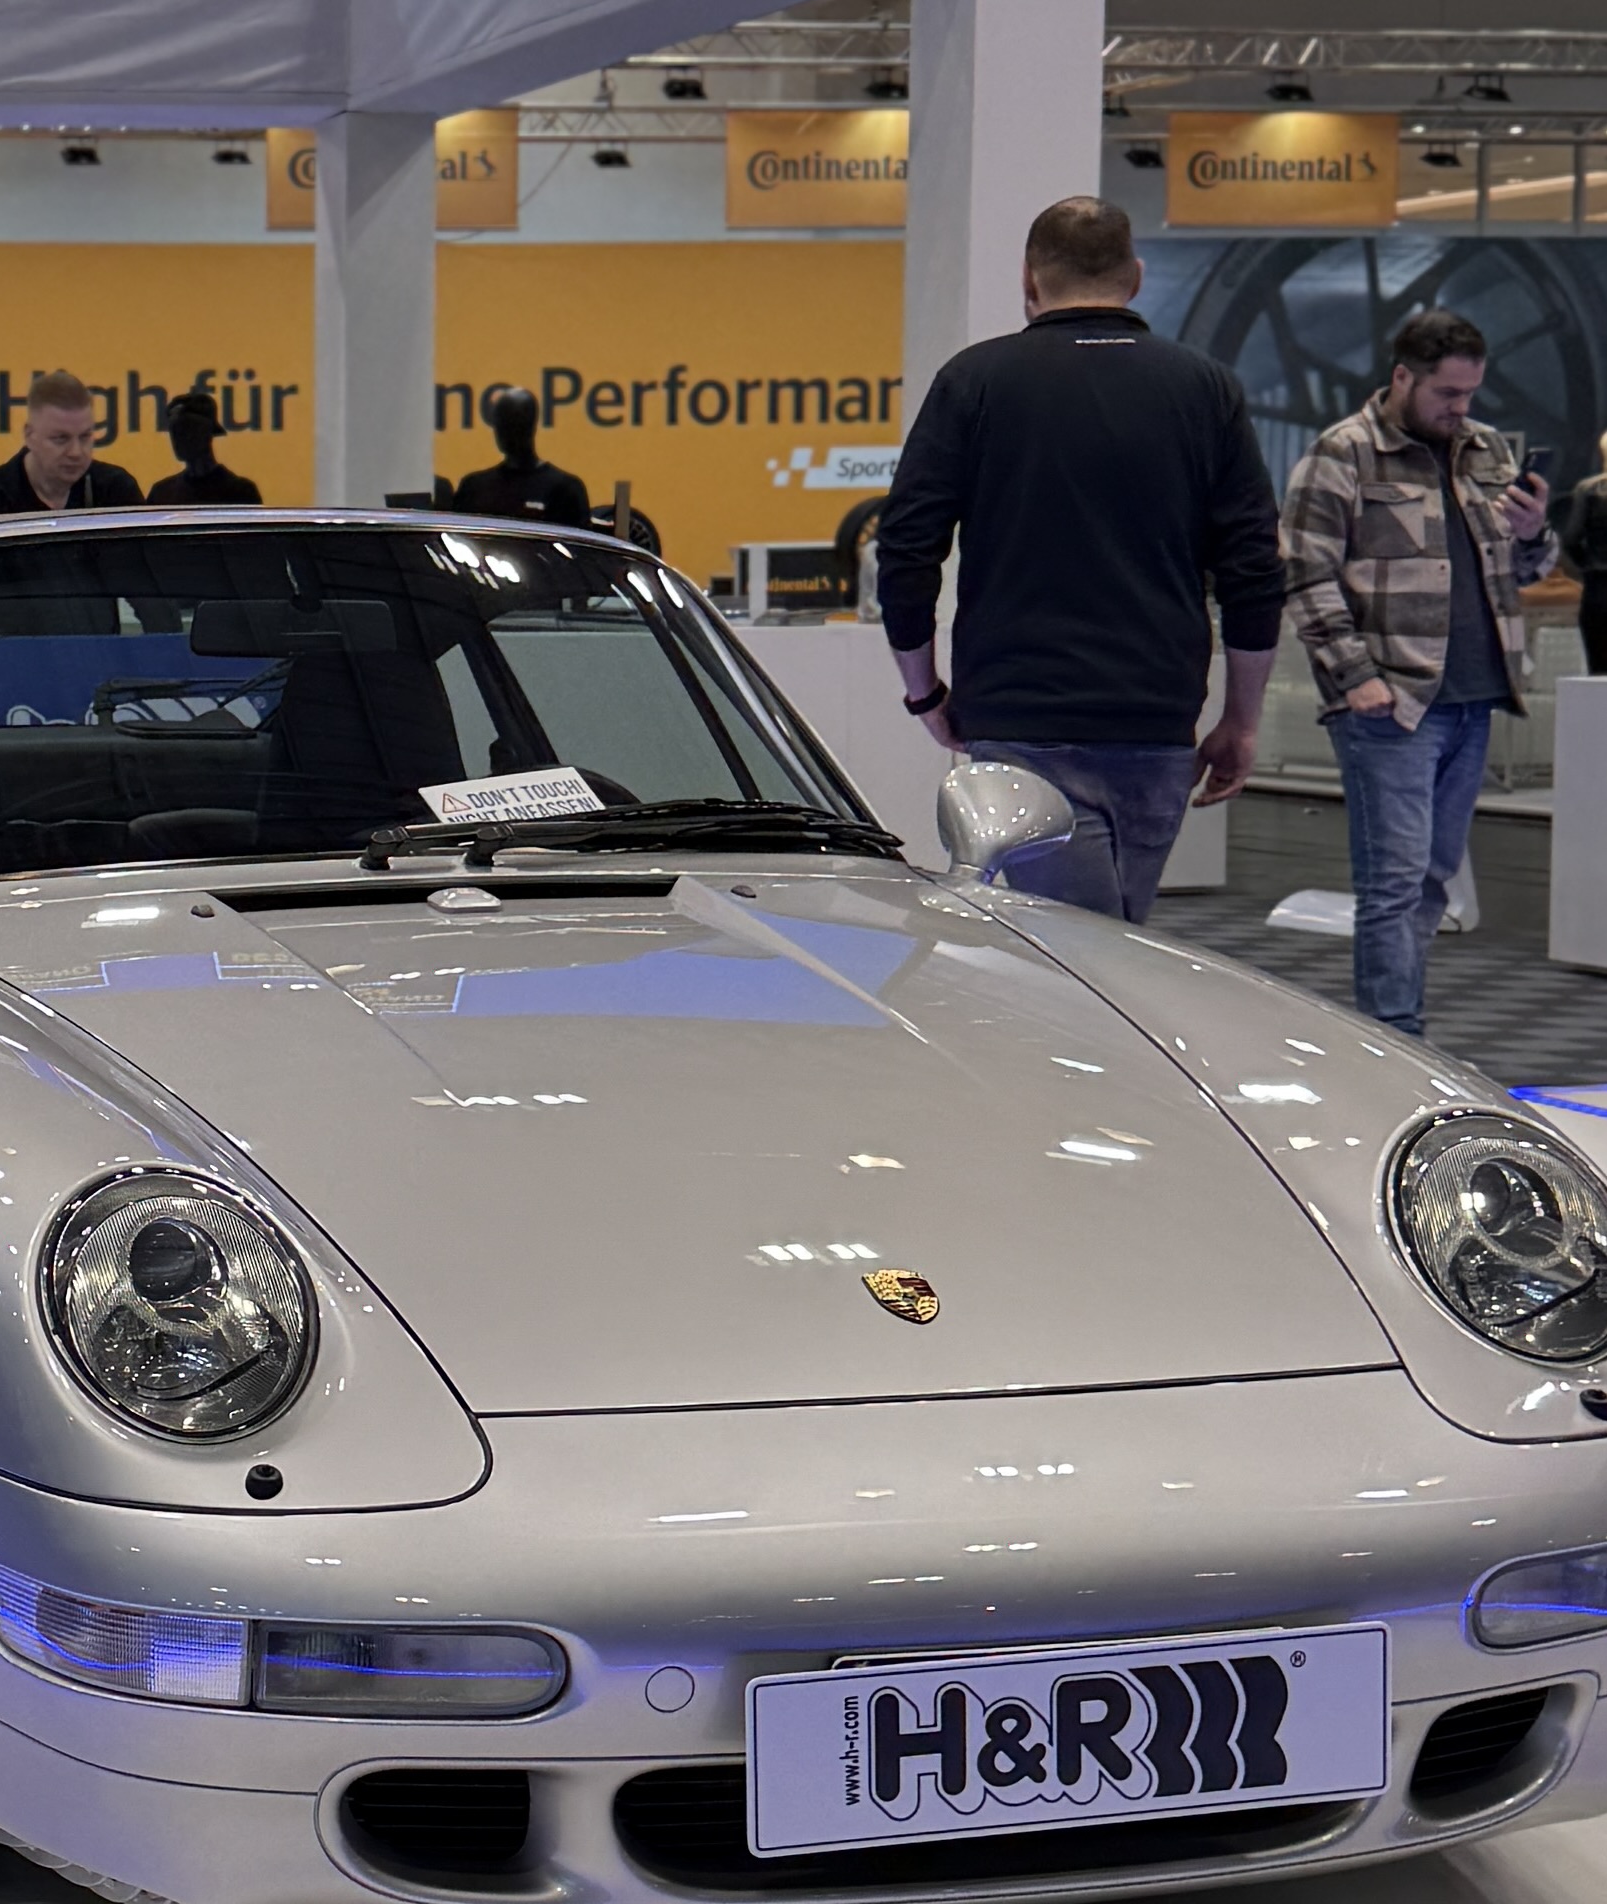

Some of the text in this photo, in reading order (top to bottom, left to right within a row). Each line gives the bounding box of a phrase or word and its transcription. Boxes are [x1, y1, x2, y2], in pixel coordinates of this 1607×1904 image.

[747, 150, 909, 190] Continenta
[1187, 150, 1352, 189] Continental
[467, 778, 587, 809] DON'T TOUCH!
[839, 1695, 861, 1806] www.h-r.com
[867, 1670, 1152, 1822] H&R
